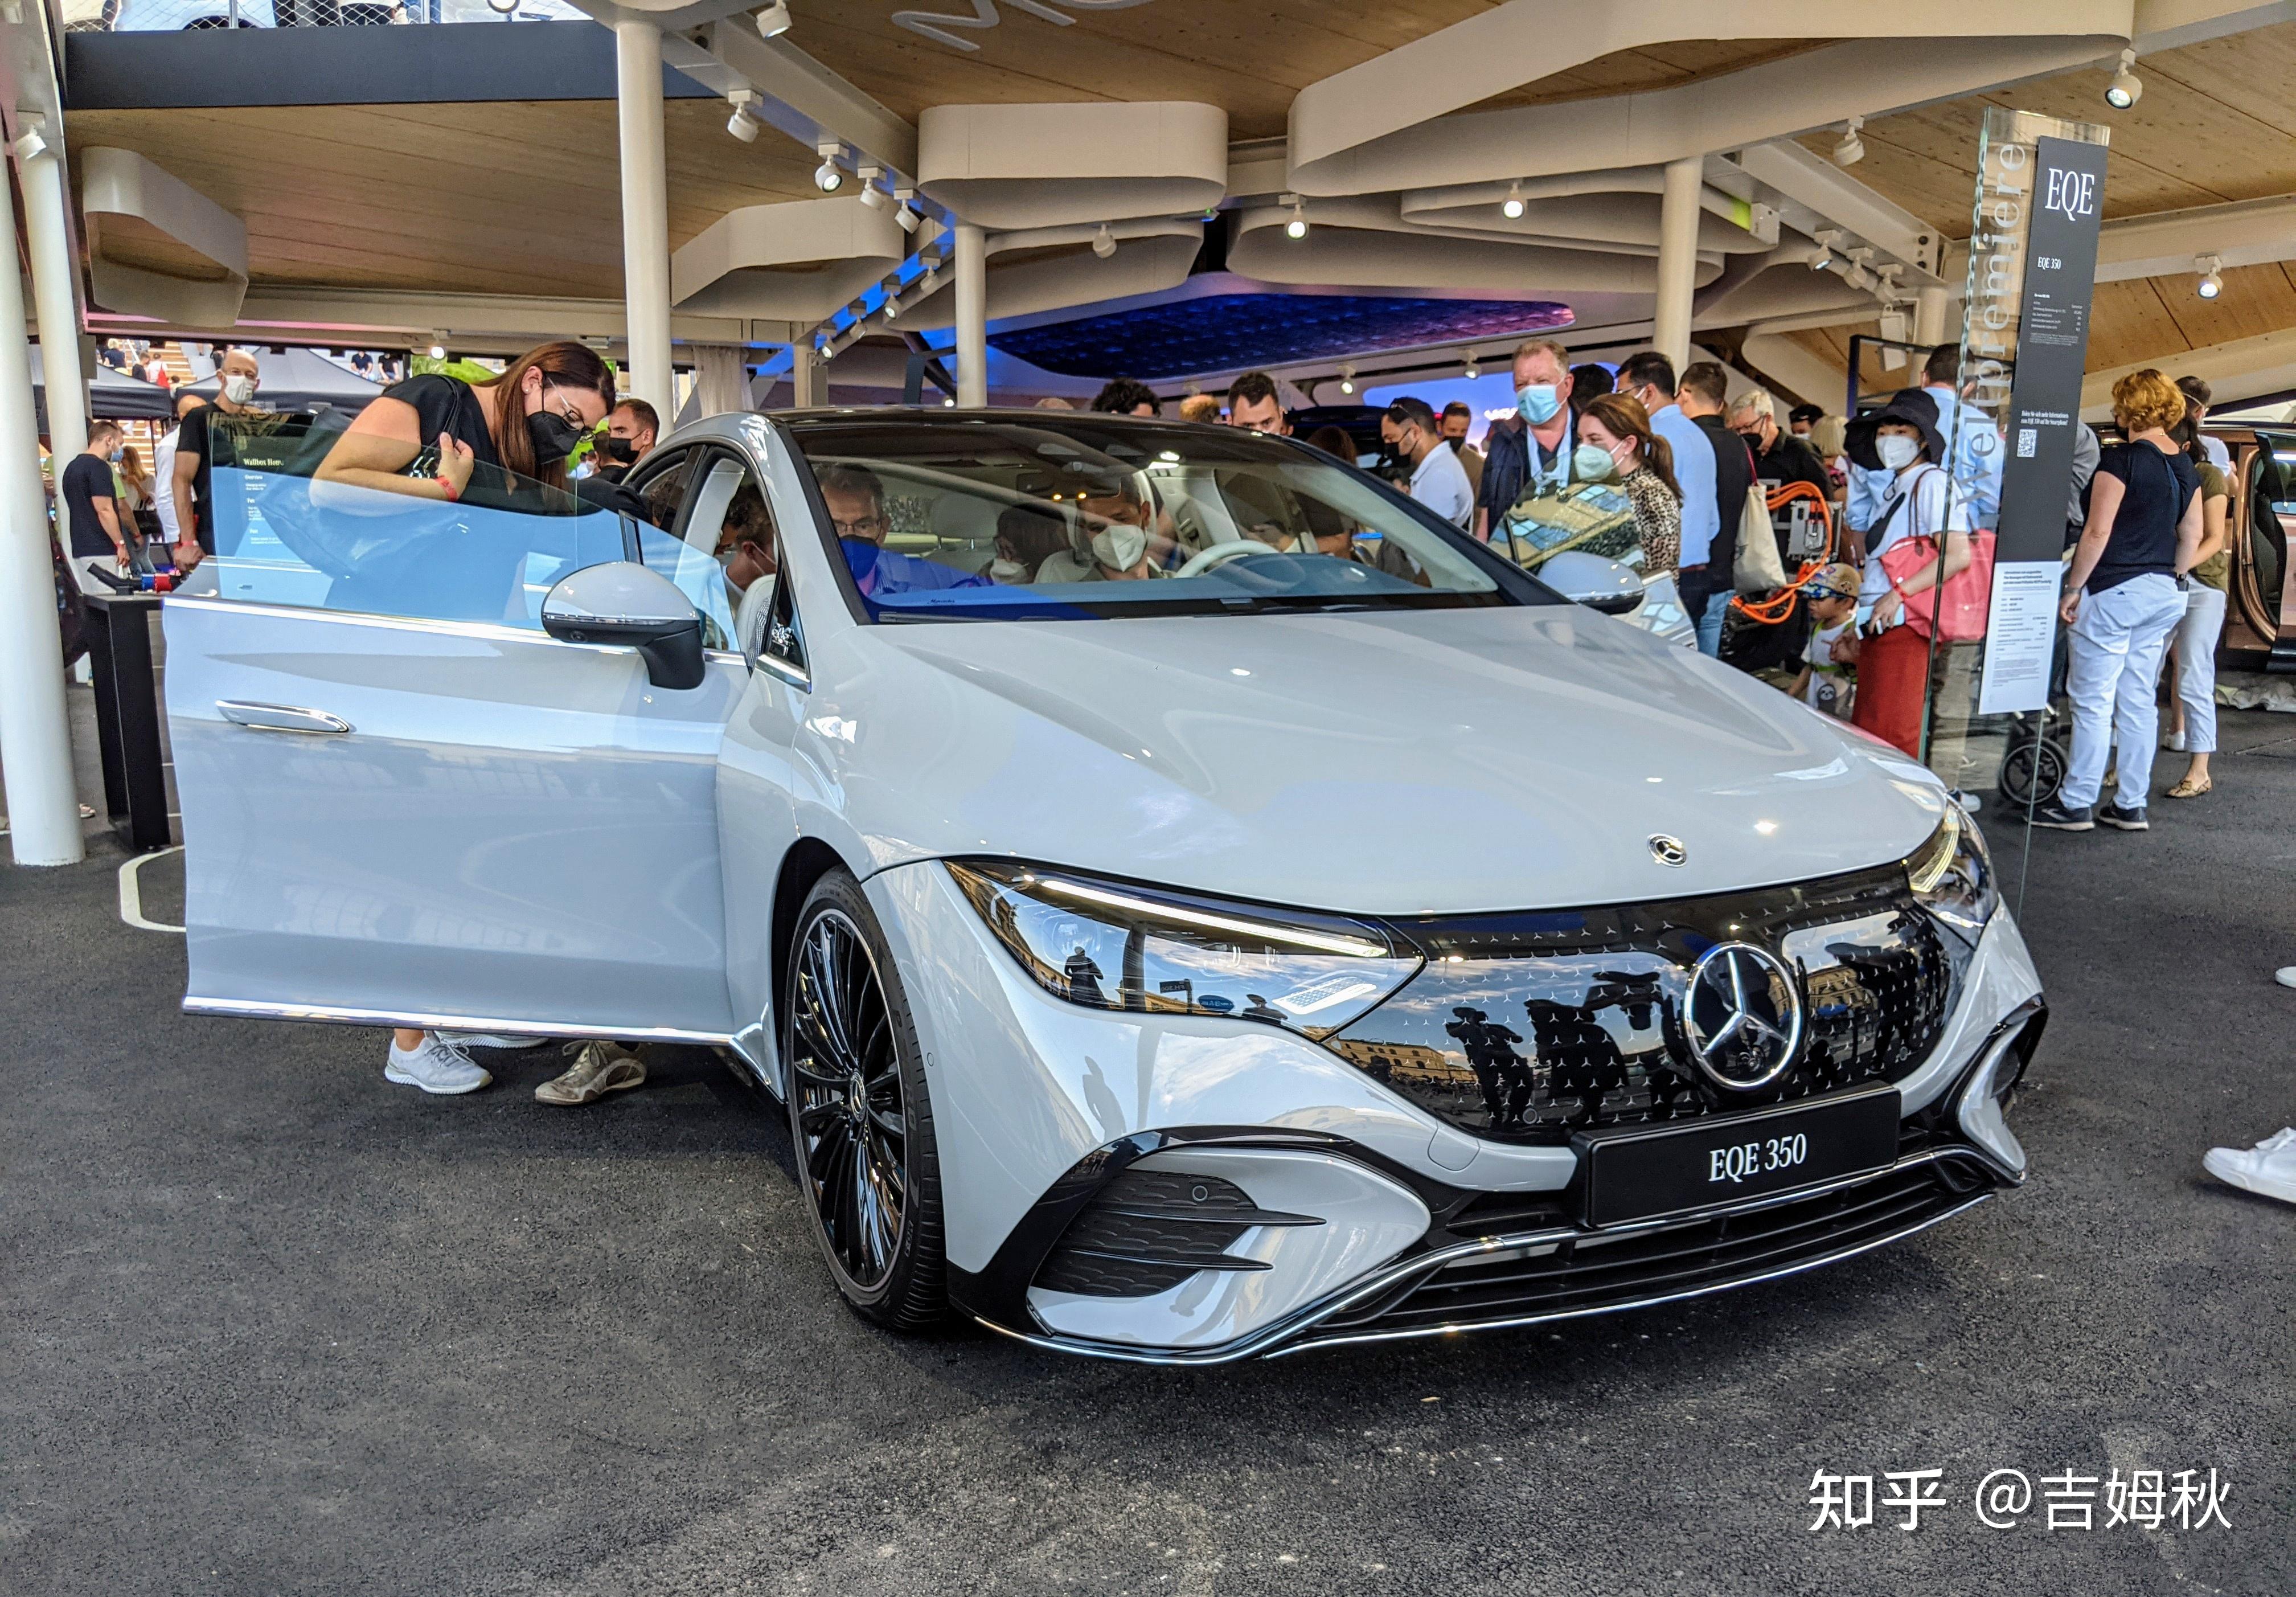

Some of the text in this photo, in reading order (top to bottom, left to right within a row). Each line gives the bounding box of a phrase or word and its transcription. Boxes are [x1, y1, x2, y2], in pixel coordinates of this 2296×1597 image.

[2044, 167, 2095, 222] EQE
[2037, 256, 2061, 270] EQE 350
[1708, 1133, 1807, 1183] EQE 350
